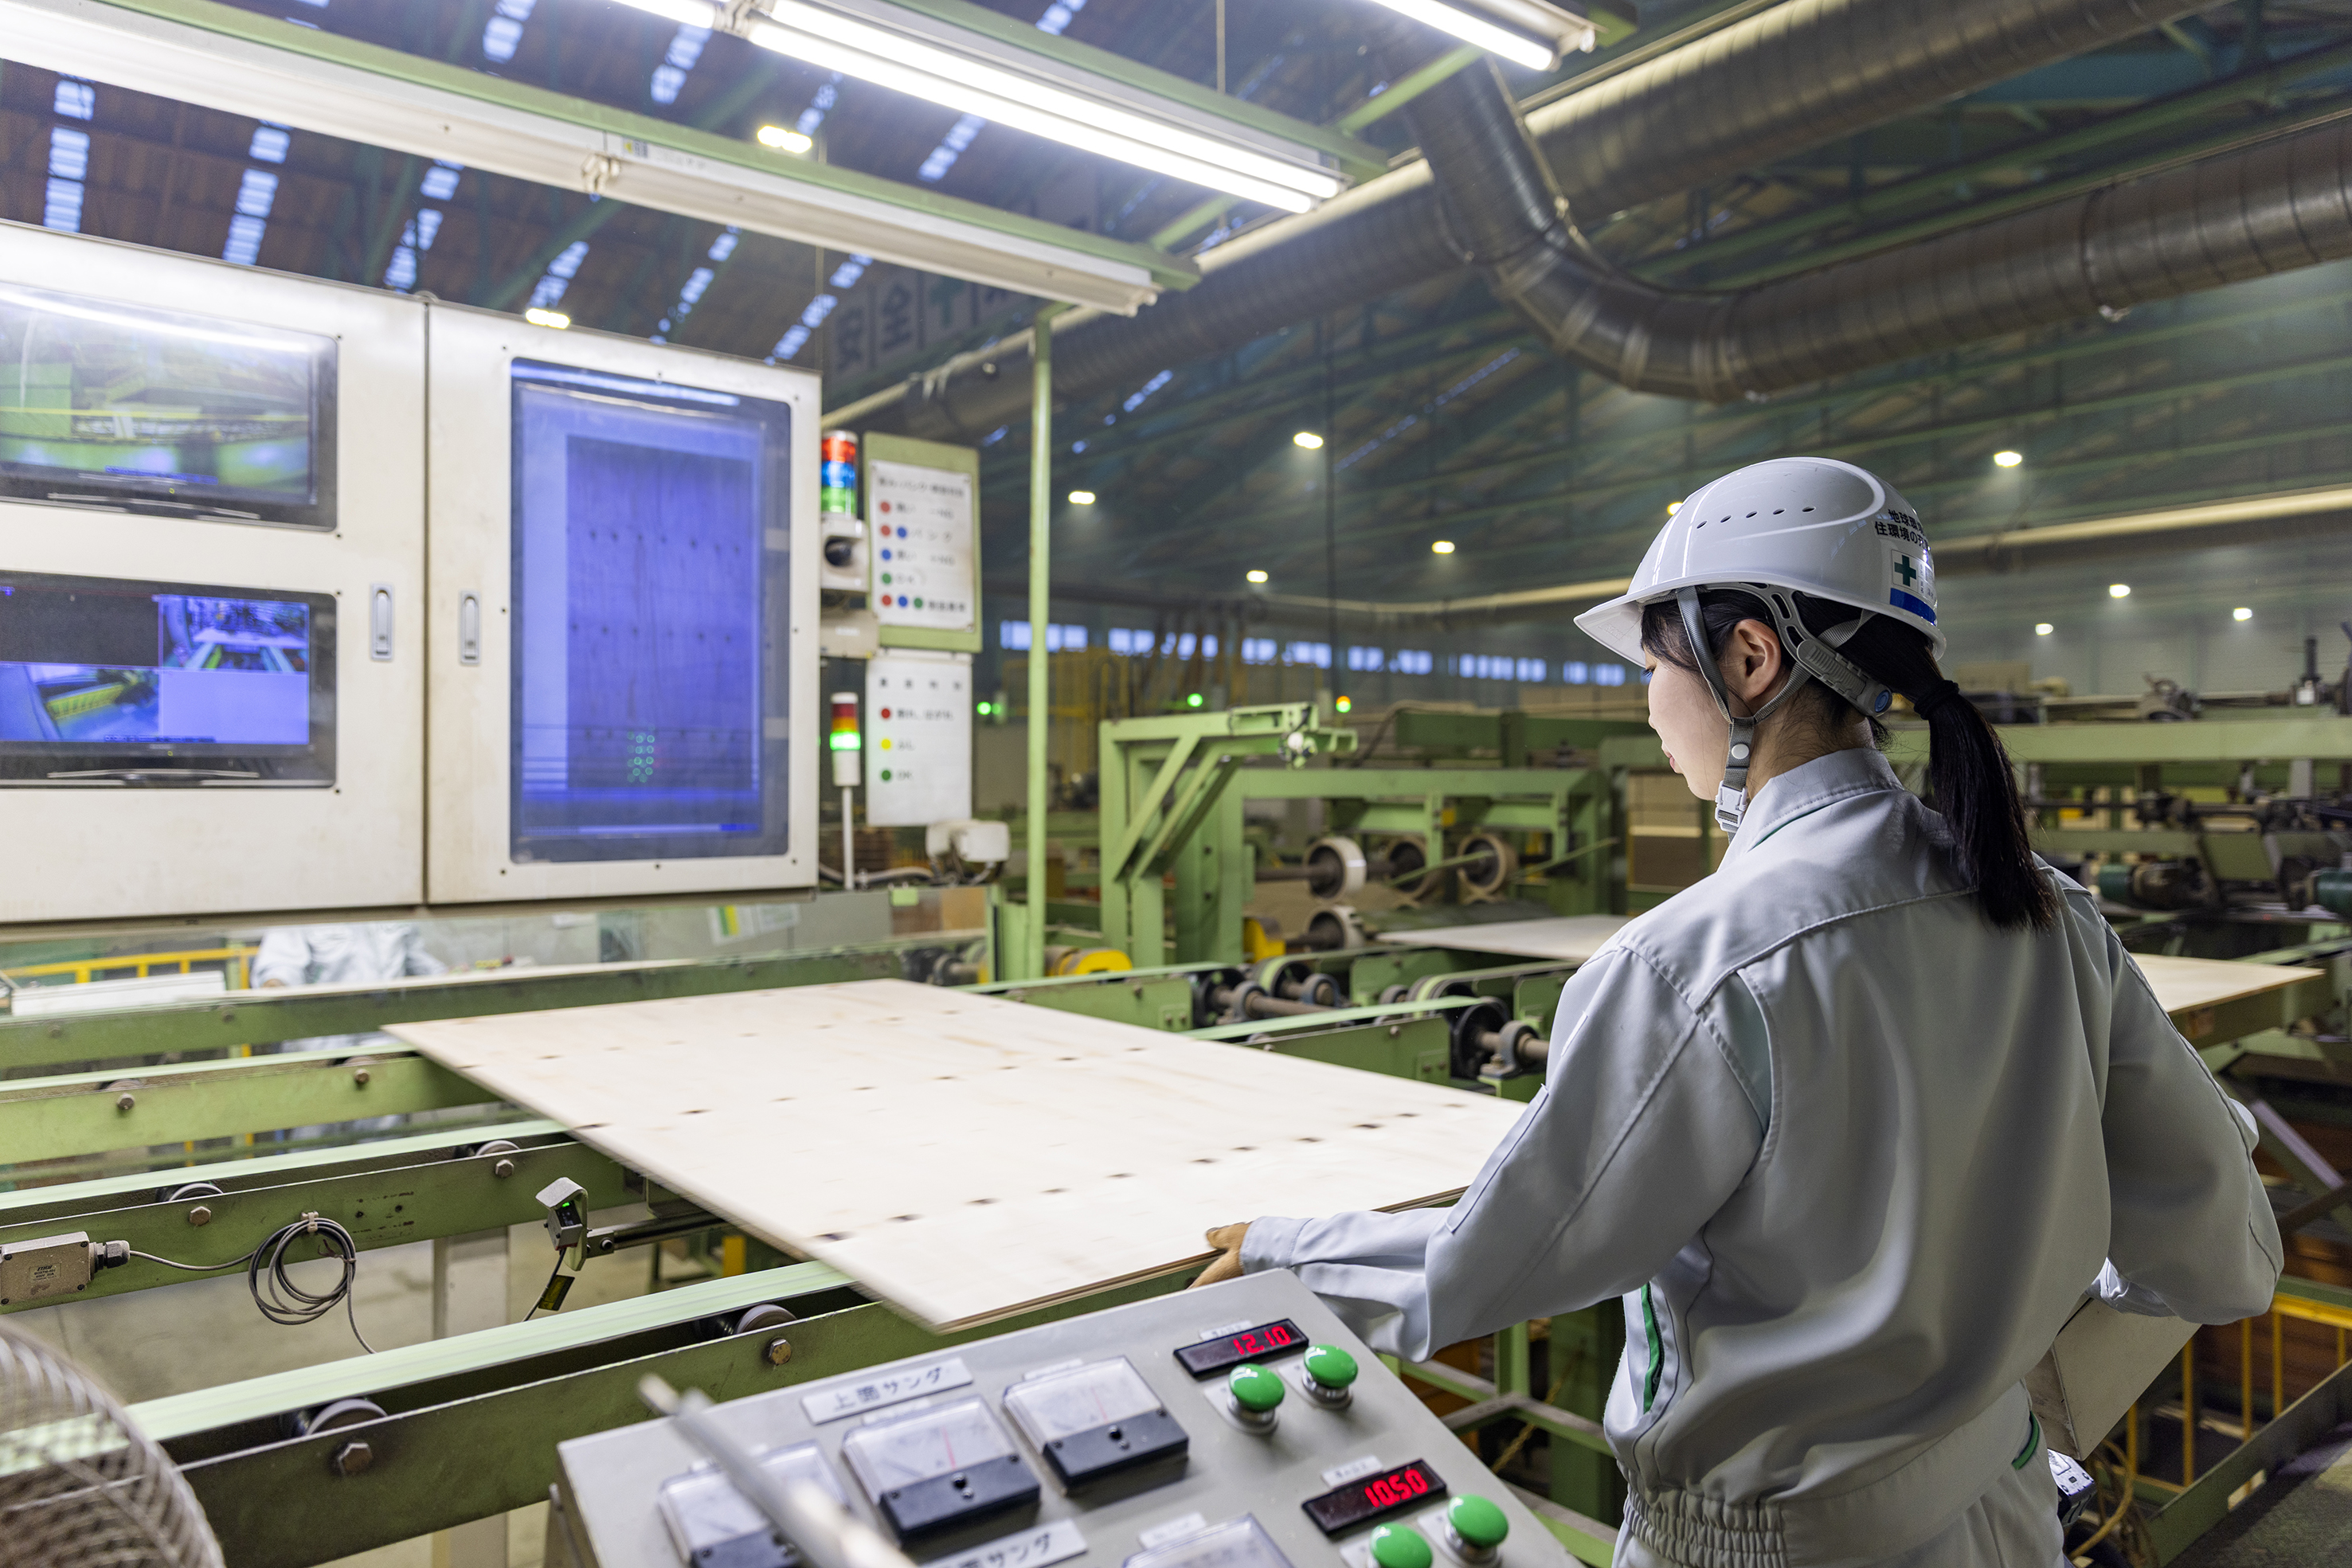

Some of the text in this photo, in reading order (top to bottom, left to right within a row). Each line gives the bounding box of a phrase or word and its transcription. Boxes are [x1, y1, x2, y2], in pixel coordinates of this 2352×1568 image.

[1875, 521, 1930, 551] 住環境の充
[1364, 1468, 1429, 1508] 10.50
